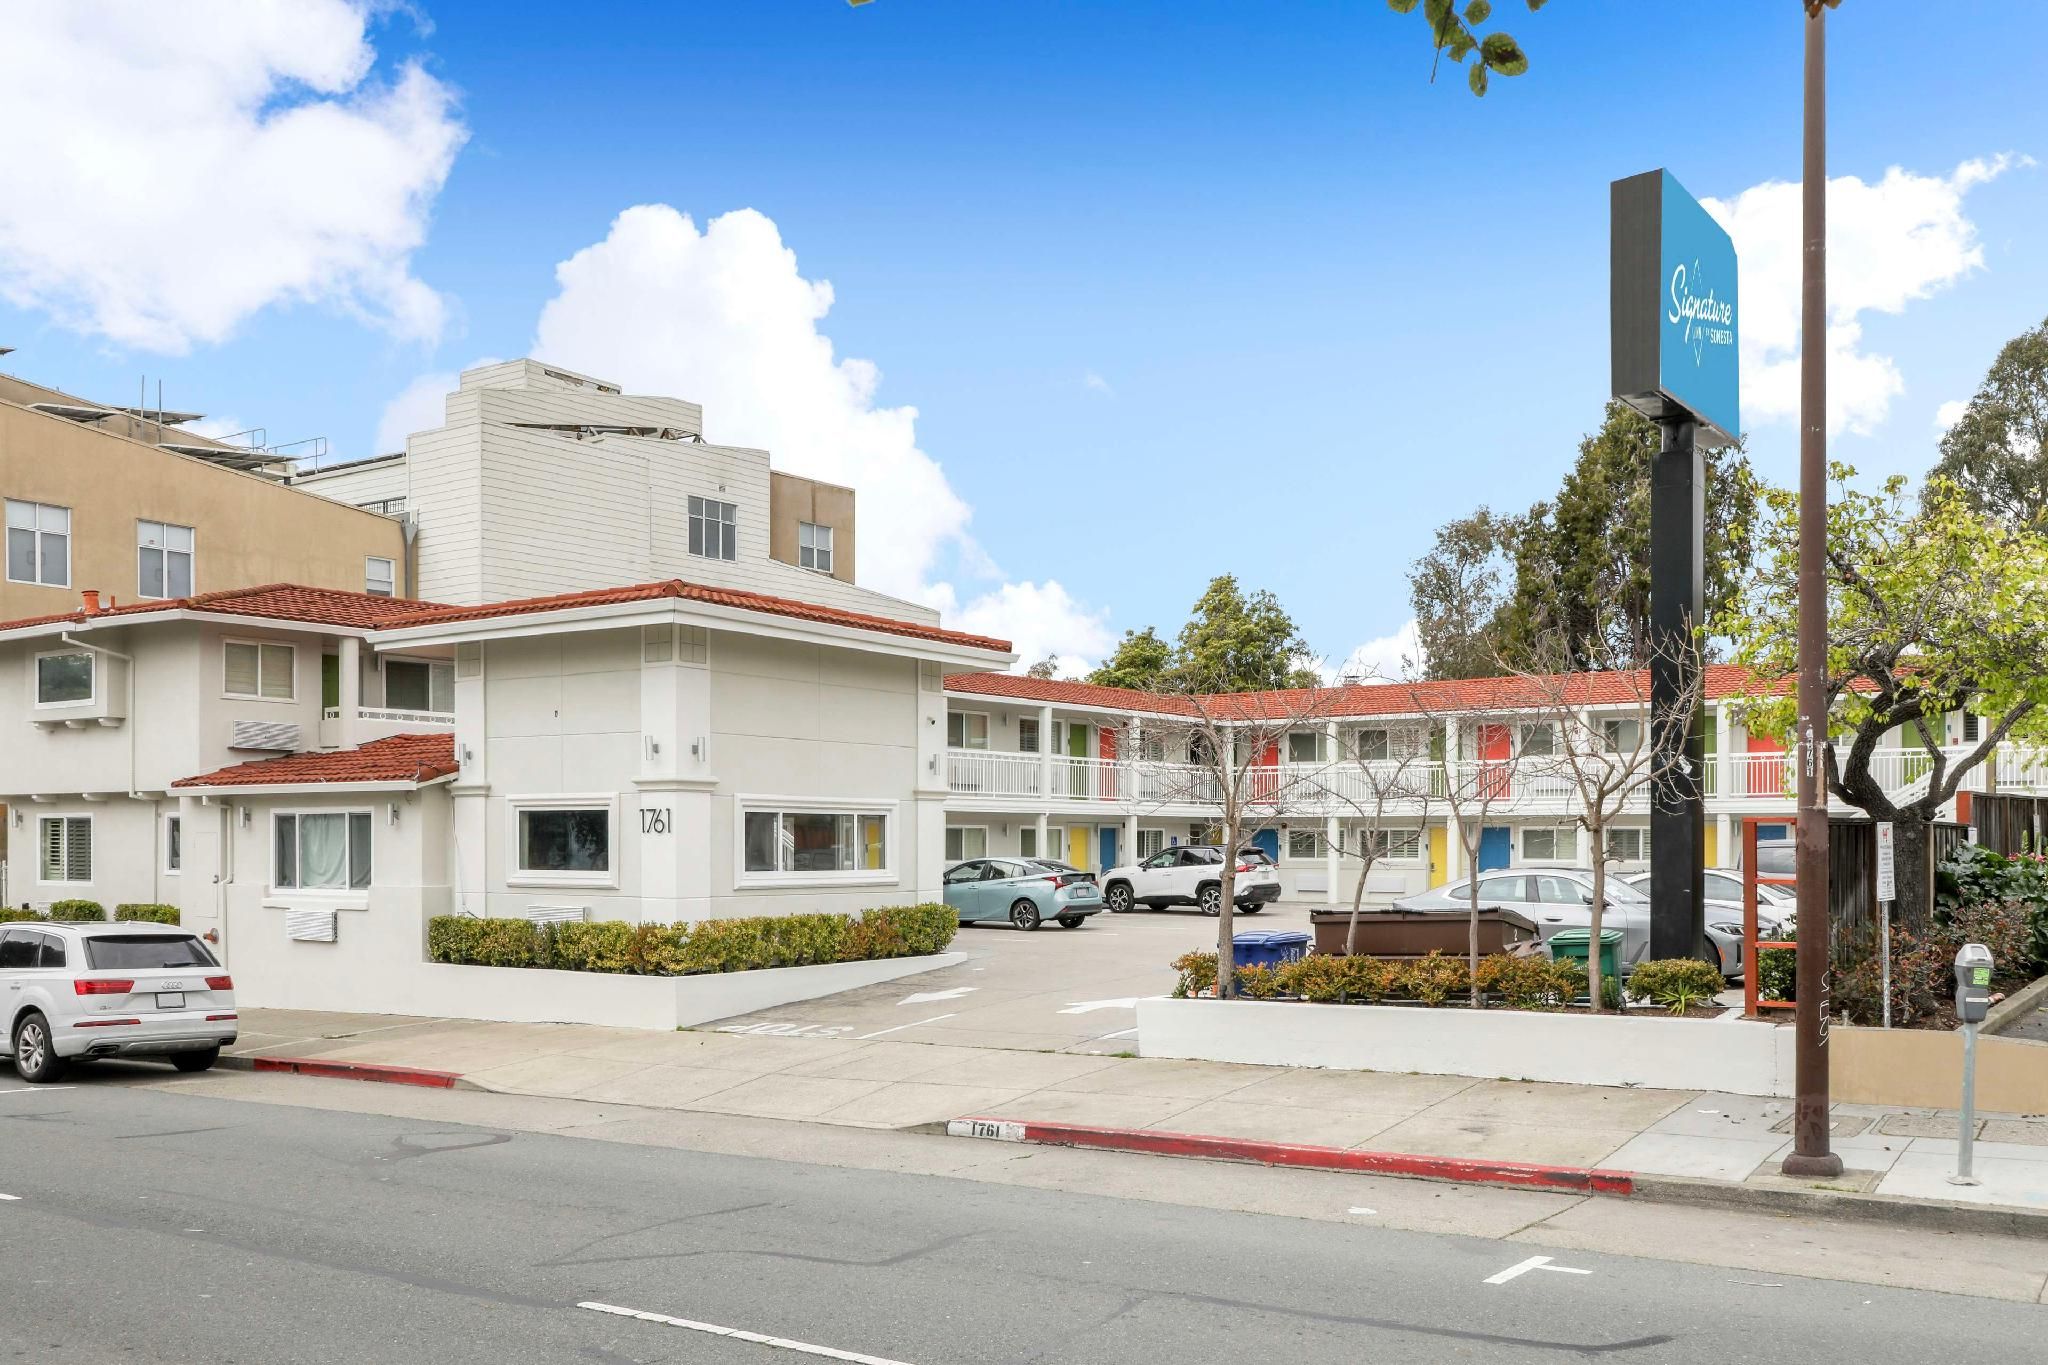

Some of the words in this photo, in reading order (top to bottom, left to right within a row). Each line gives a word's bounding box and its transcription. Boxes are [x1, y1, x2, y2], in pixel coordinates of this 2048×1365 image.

[1668, 263, 1732, 344] Signature
[639, 808, 671, 833] 1761
[970, 1120, 1000, 1138] 1761
